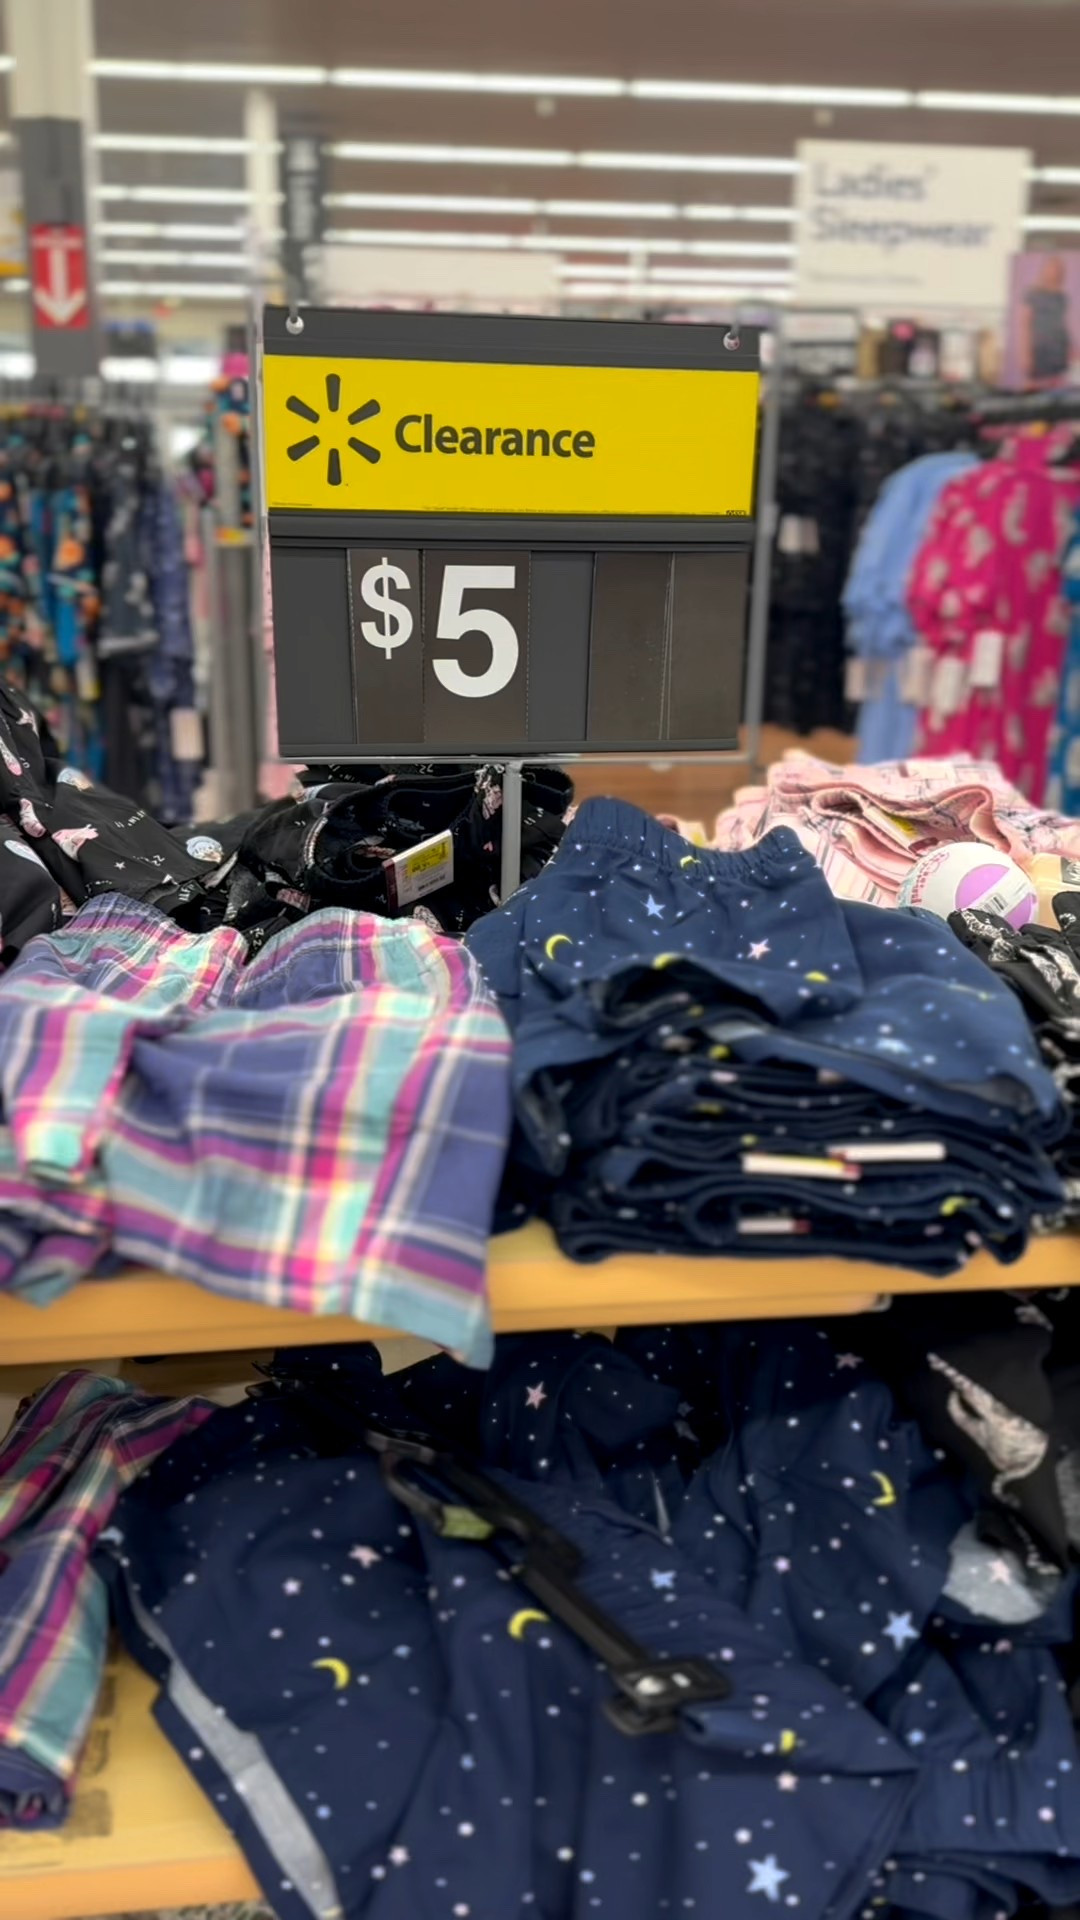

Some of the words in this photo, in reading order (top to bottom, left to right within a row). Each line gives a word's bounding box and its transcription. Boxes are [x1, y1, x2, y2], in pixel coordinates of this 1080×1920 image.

[810, 204, 994, 253] Sleepwear
[395, 413, 596, 459] Clearance
[360, 556, 520, 698] $5
